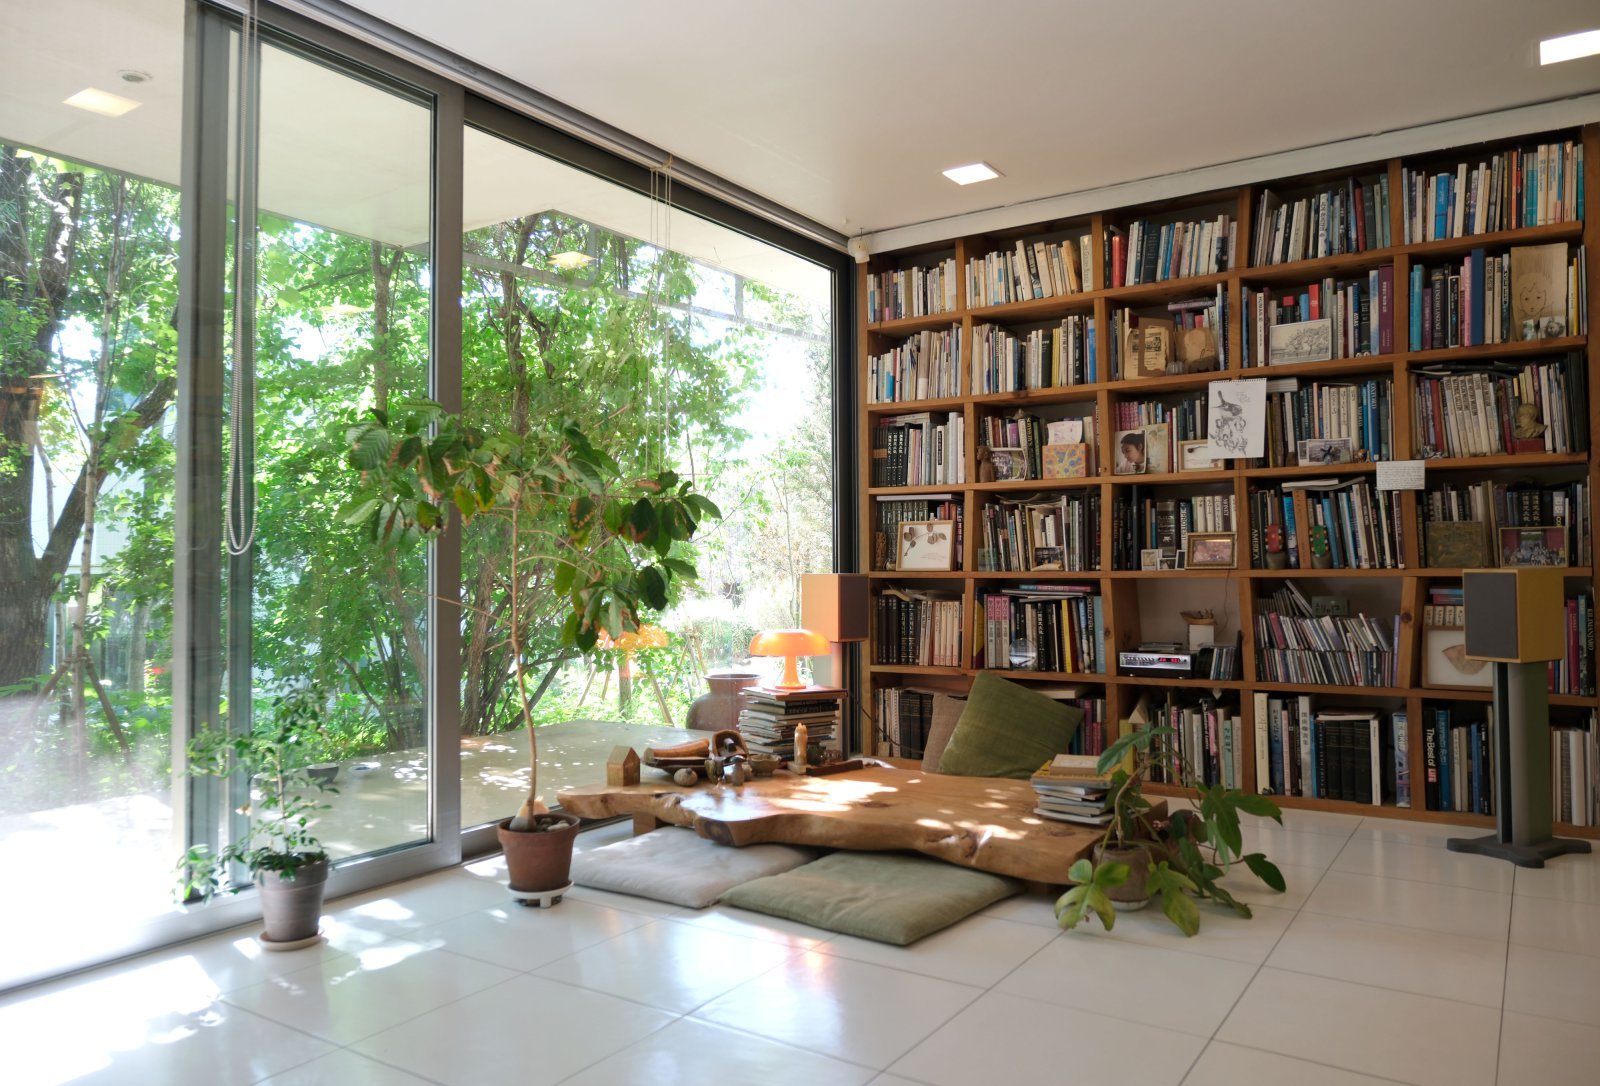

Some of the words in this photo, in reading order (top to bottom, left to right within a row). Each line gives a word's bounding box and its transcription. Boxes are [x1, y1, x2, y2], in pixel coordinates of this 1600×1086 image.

[1426, 728, 1435, 742] The
[1427, 742, 1436, 758] Best
[1427, 759, 1436, 767] of
[1428, 768, 1437, 782] LIFE
